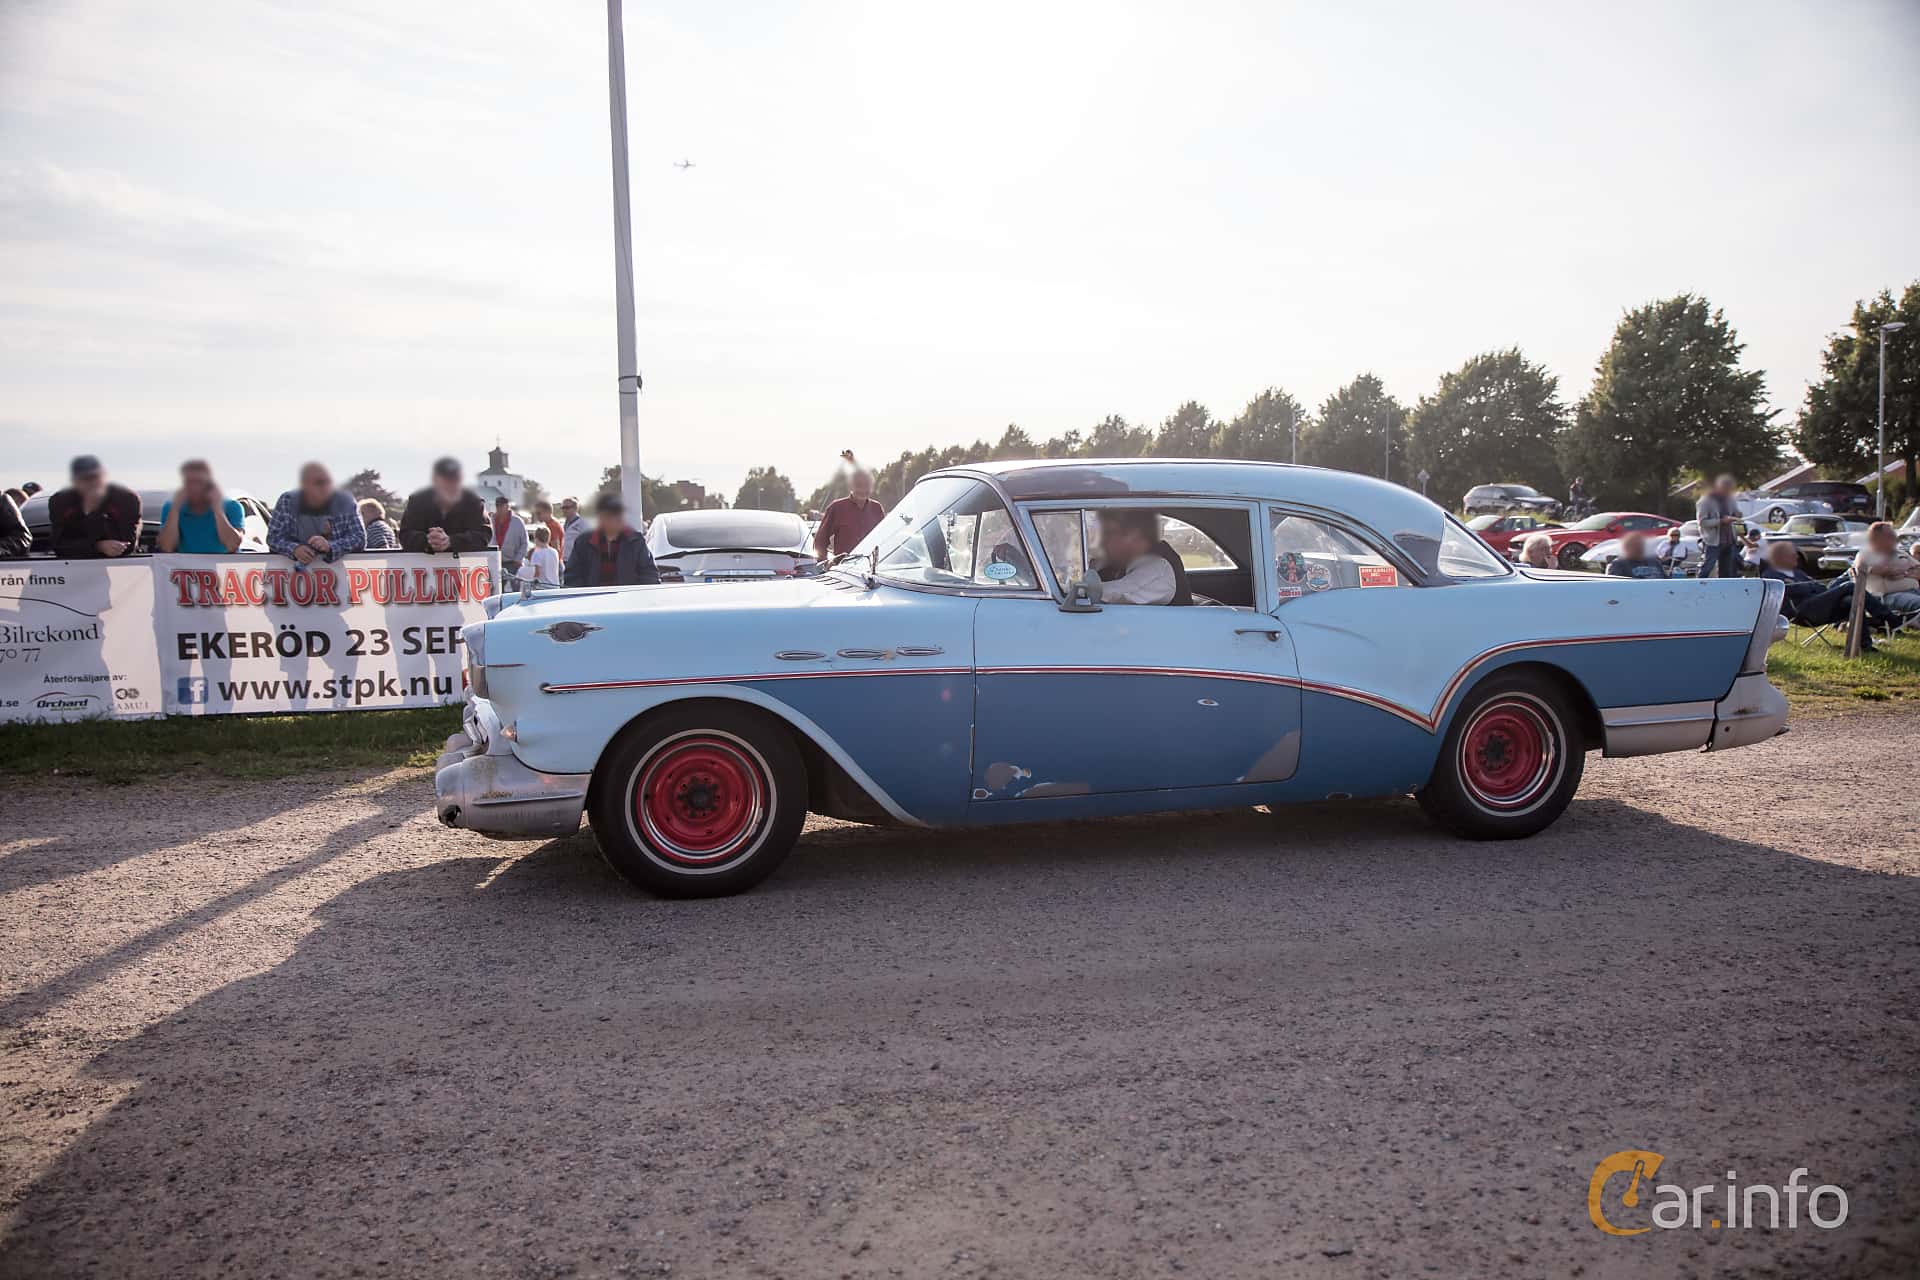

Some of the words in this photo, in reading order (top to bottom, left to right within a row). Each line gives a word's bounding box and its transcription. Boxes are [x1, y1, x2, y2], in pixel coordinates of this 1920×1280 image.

[29, 574, 66, 585] finns
[170, 567, 340, 607] TRACTOR
[346, 565, 495, 605] PULLING
[0, 622, 100, 644] Bilrekond
[177, 624, 331, 660] EKERÖD
[345, 628, 391, 657] 23
[22, 647, 41, 663] 77
[43, 673, 110, 685] Återförsäljare
[217, 670, 453, 705] www.stpk.nu
[37, 699, 88, 709] Orchard
